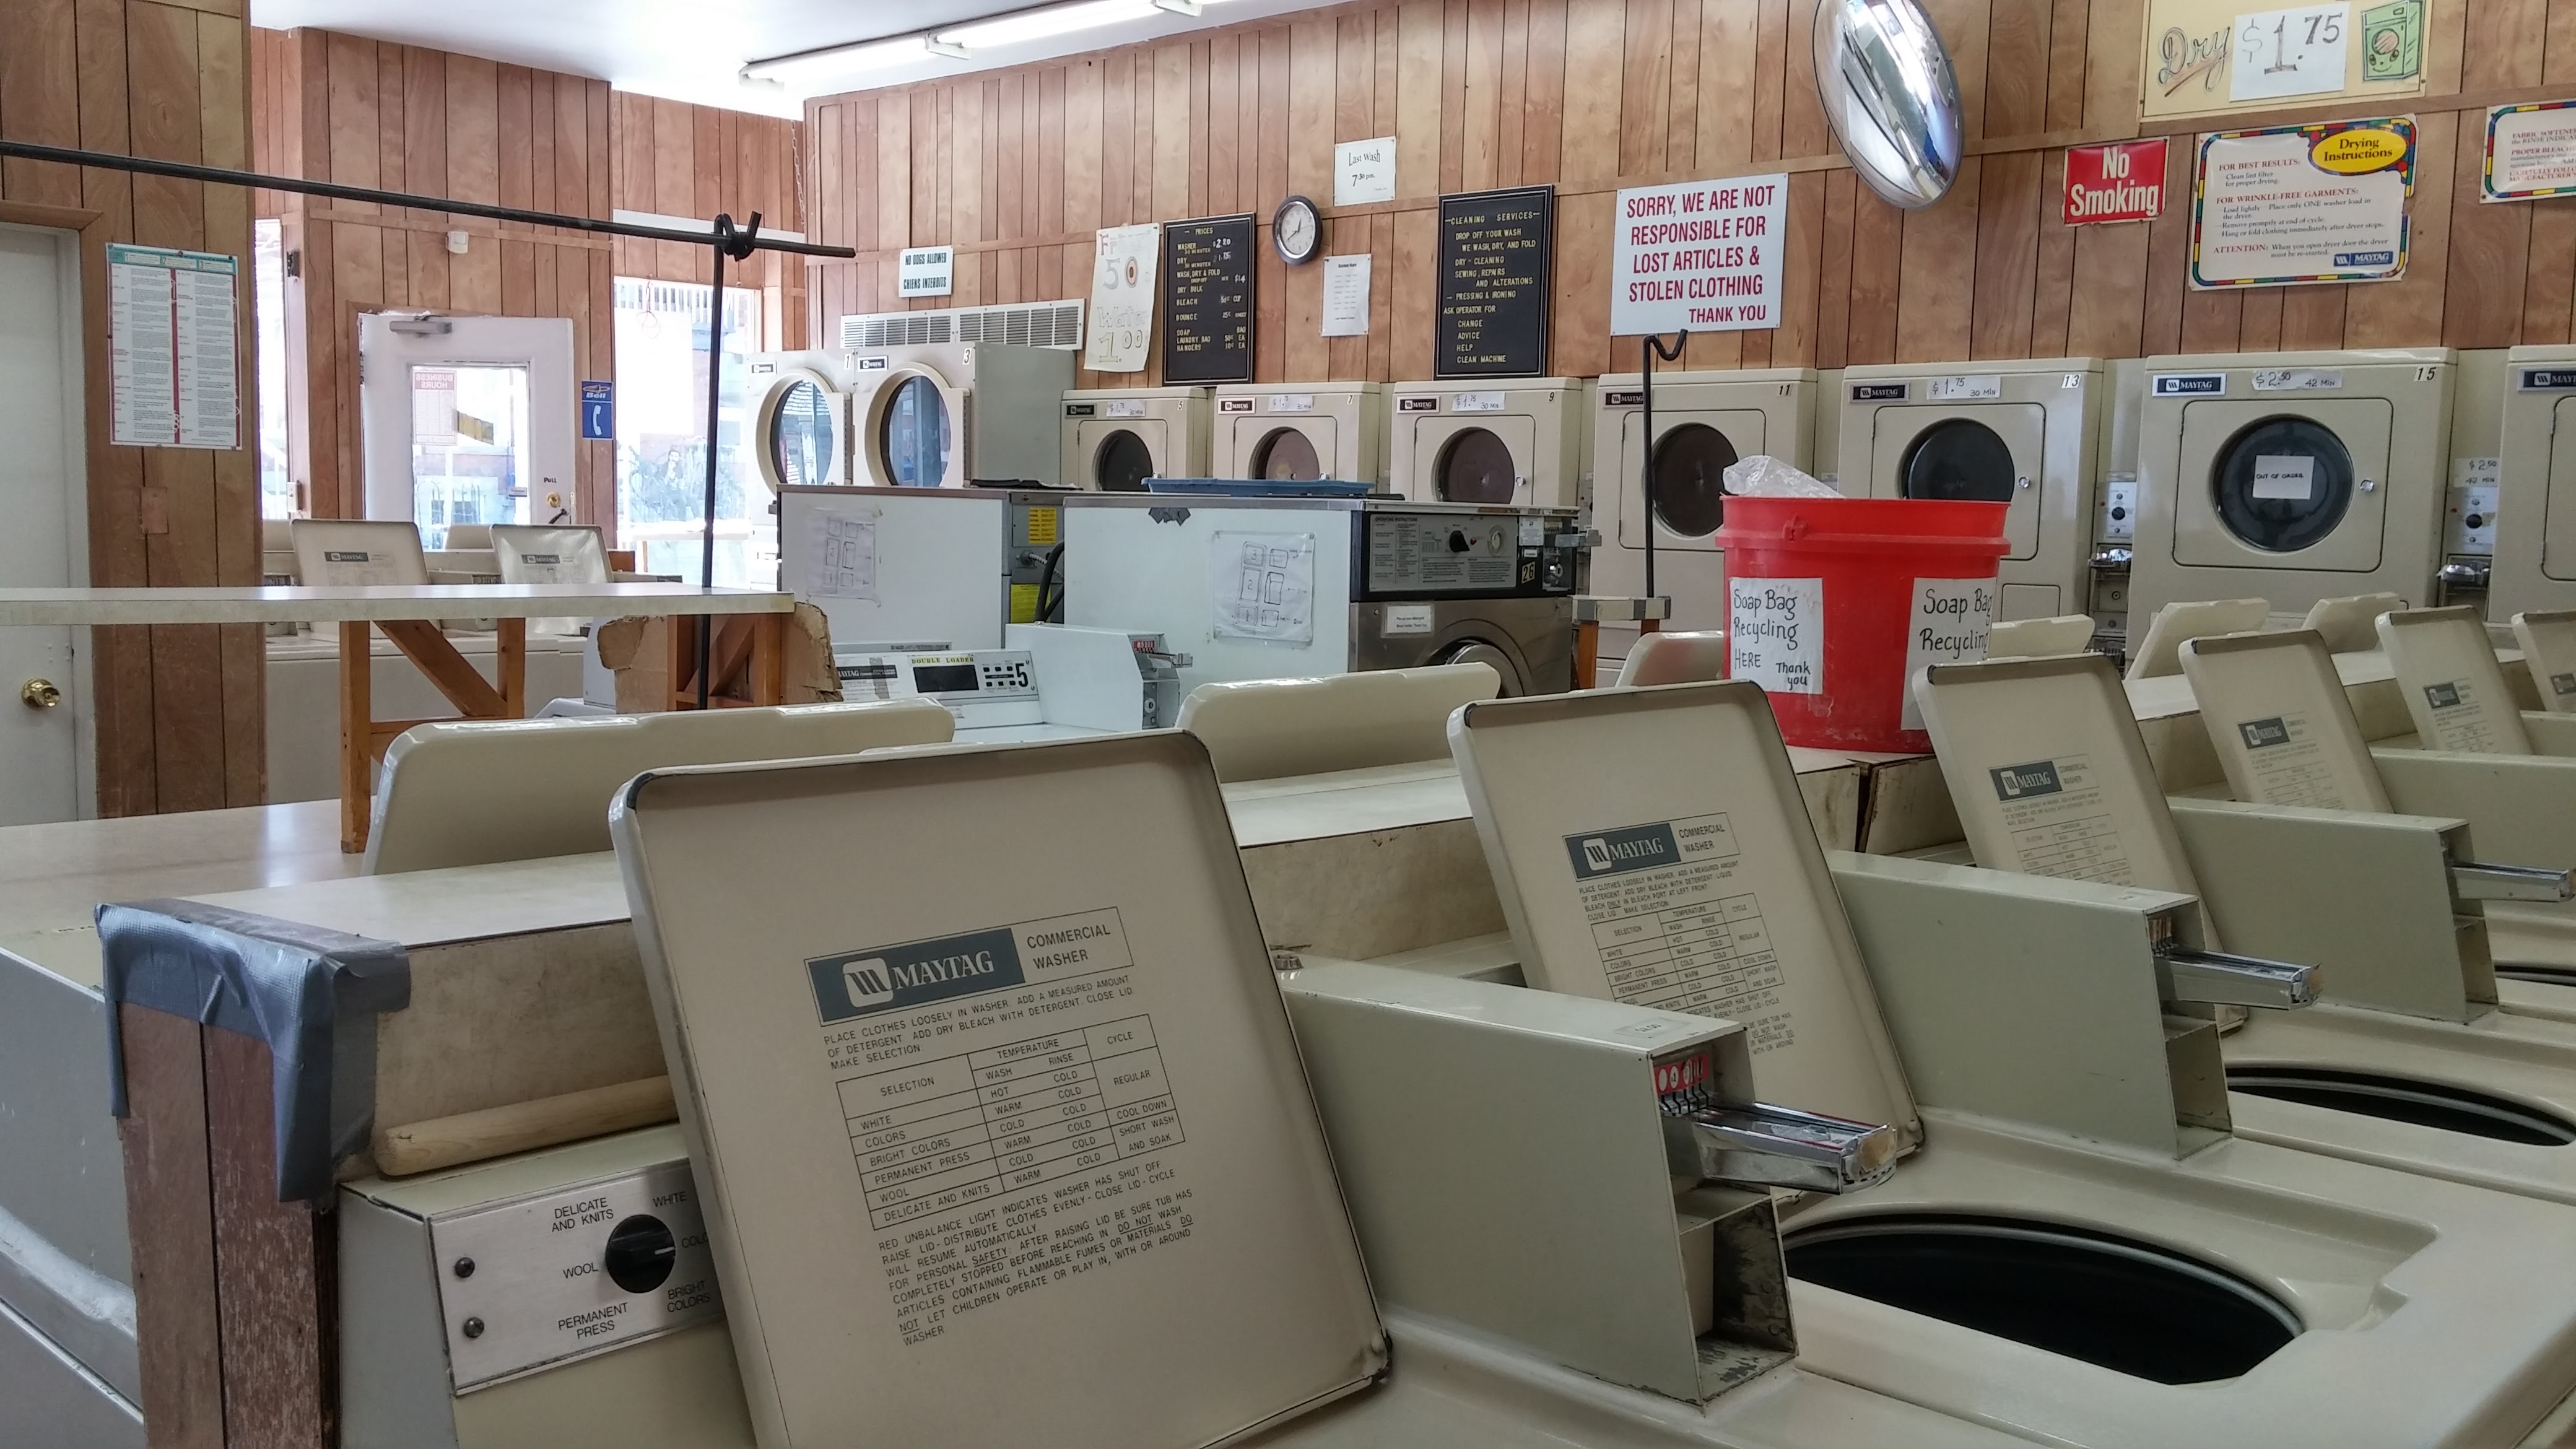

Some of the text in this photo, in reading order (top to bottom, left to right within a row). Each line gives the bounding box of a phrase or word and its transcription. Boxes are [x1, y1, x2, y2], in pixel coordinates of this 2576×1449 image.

[2158, 27, 2230, 92] Dry
[2339, 137, 2379, 150] Drying
[1349, 149, 1380, 166] Last Wash
[2102, 146, 2130, 180] No
[2324, 149, 2393, 162] Instructions
[1352, 173, 1364, 186] 7:30
[1627, 185, 1775, 218] SORRY, WE ARE NOT
[2070, 183, 2159, 216] Smoking
[2237, 192, 2301, 202] WRINKLE-FREE
[2305, 188, 2358, 198] GARMENTS:
[1451, 211, 1533, 225] CLEANING SERVICES
[1456, 228, 1521, 240] DROP OFF YOUR WASH
[1631, 215, 1766, 245] RESPONSIBLE FOR
[2213, 244, 2269, 254] ATTENTION:
[2354, 253, 2389, 261] MAYTAG
[905, 253, 946, 265] NO DOGS ALLOWED
[1455, 256, 1505, 266] DRY CLEANING
[1634, 245, 1760, 274] LOST ARTICLES &
[903, 277, 946, 289] CHIENS INTERDITS
[1493, 277, 1533, 287] ALTERATIONS
[1629, 274, 1762, 302] STOLEN CLOTHING
[1456, 292, 1483, 300] PRESSING
[1492, 290, 1516, 298] IRONING
[1456, 306, 1482, 314] OPERATOR
[1689, 305, 1766, 323] THANK YOU
[1456, 344, 1473, 352] HELP
[846, 355, 850, 368] 1
[964, 350, 970, 363] 3
[1481, 355, 1507, 363] MACHINE
[2065, 375, 2079, 387] 13
[2417, 367, 2437, 380] 15
[1779, 385, 1790, 396] 11
[1871, 388, 1899, 397] MAYTAG
[2179, 381, 2212, 389] MAYTAG
[1348, 395, 1352, 404] 7
[1549, 392, 1554, 401] 9
[1178, 401, 1183, 409] 5
[1523, 564, 1533, 581] 26
[1733, 589, 1798, 620] Soap Bag
[1923, 588, 1993, 626] Soap Bag
[1733, 617, 1798, 651] Recycling
[1734, 648, 1762, 669] HERE
[1016, 663, 1029, 687] 5
[1775, 661, 1811, 675] Thank
[1787, 674, 1808, 690] you
[2018, 772, 2051, 789] MAYTAG
[1679, 824, 1725, 838] COMMERCIAL
[1609, 837, 1664, 861] MAYTAG
[1684, 840, 1715, 853] WASHER
[1027, 924, 1111, 949] COMMERCIAL
[1033, 949, 1089, 969] WASHER
[891, 950, 995, 990] MAYTAG
[824, 1032, 857, 1045] PLACE
[861, 1020, 907, 1037] CLOTHES
[911, 1011, 953, 1027] LOOSELY
[957, 1008, 968, 1017] IN
[1017, 993, 1035, 1004] ADD
[1039, 991, 1046, 1000] A
[1048, 983, 1093, 998] MEASURED
[1097, 975, 1130, 988] AMOUNT
[996, 1031, 1134, 1060] TEMPERATURE CYCLE
[830, 1058, 861, 1071] MAKE
[880, 1053, 1074, 1098] SELECTION WASH RINSE
[990, 1069, 1151, 1099] HOT COLD REGULAR
[555, 1191, 688, 1219] DELICATE WHITE
[552, 1208, 614, 1233] AND KNITS
[681, 1232, 710, 1248] COLO
[563, 1263, 599, 1279] WOOL
[668, 1281, 706, 1300] BRIGHT
[666, 1292, 711, 1313] COLORS
[557, 1302, 629, 1331] PERMANENT
[577, 1321, 616, 1339] PRESS
